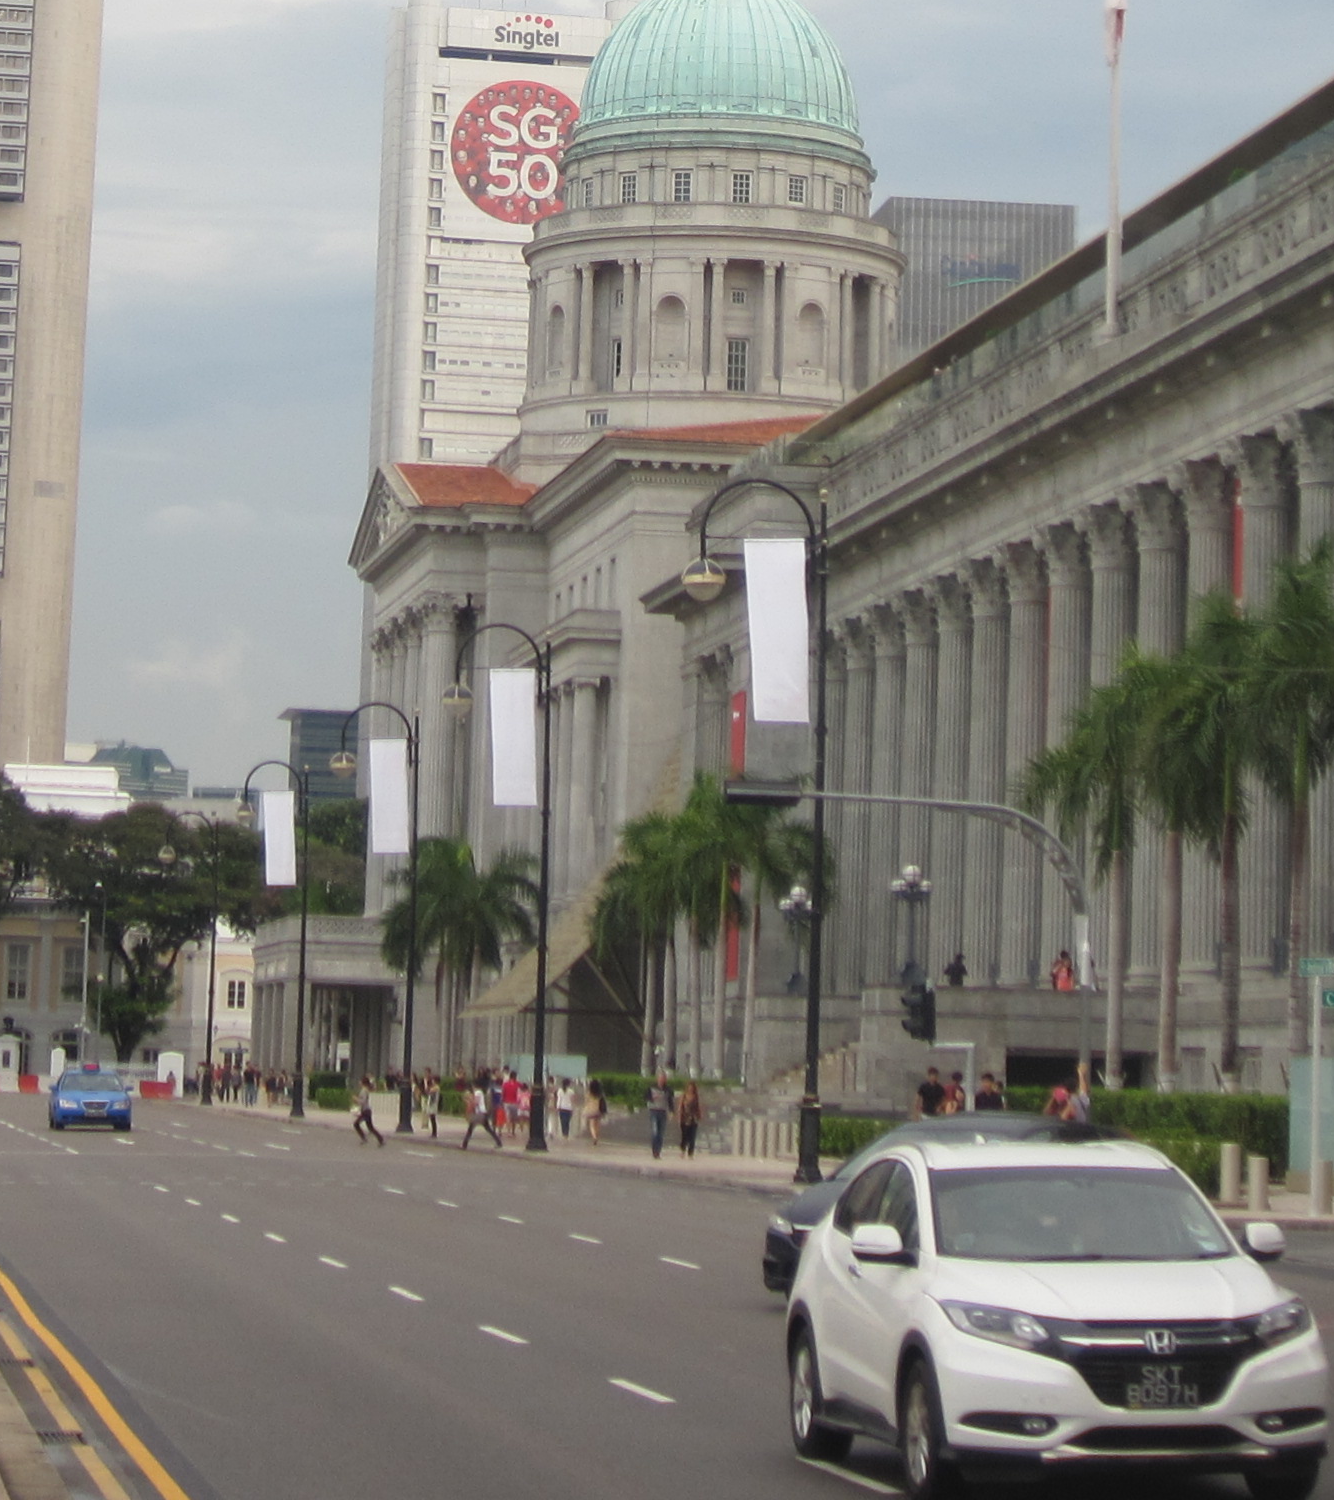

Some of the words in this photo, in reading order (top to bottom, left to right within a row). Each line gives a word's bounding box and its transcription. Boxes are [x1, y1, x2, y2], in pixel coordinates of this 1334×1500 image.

[494, 25, 559, 49] Singtel
[487, 104, 557, 149] SG
[486, 150, 559, 199] 50
[1141, 1365, 1183, 1385] SKT
